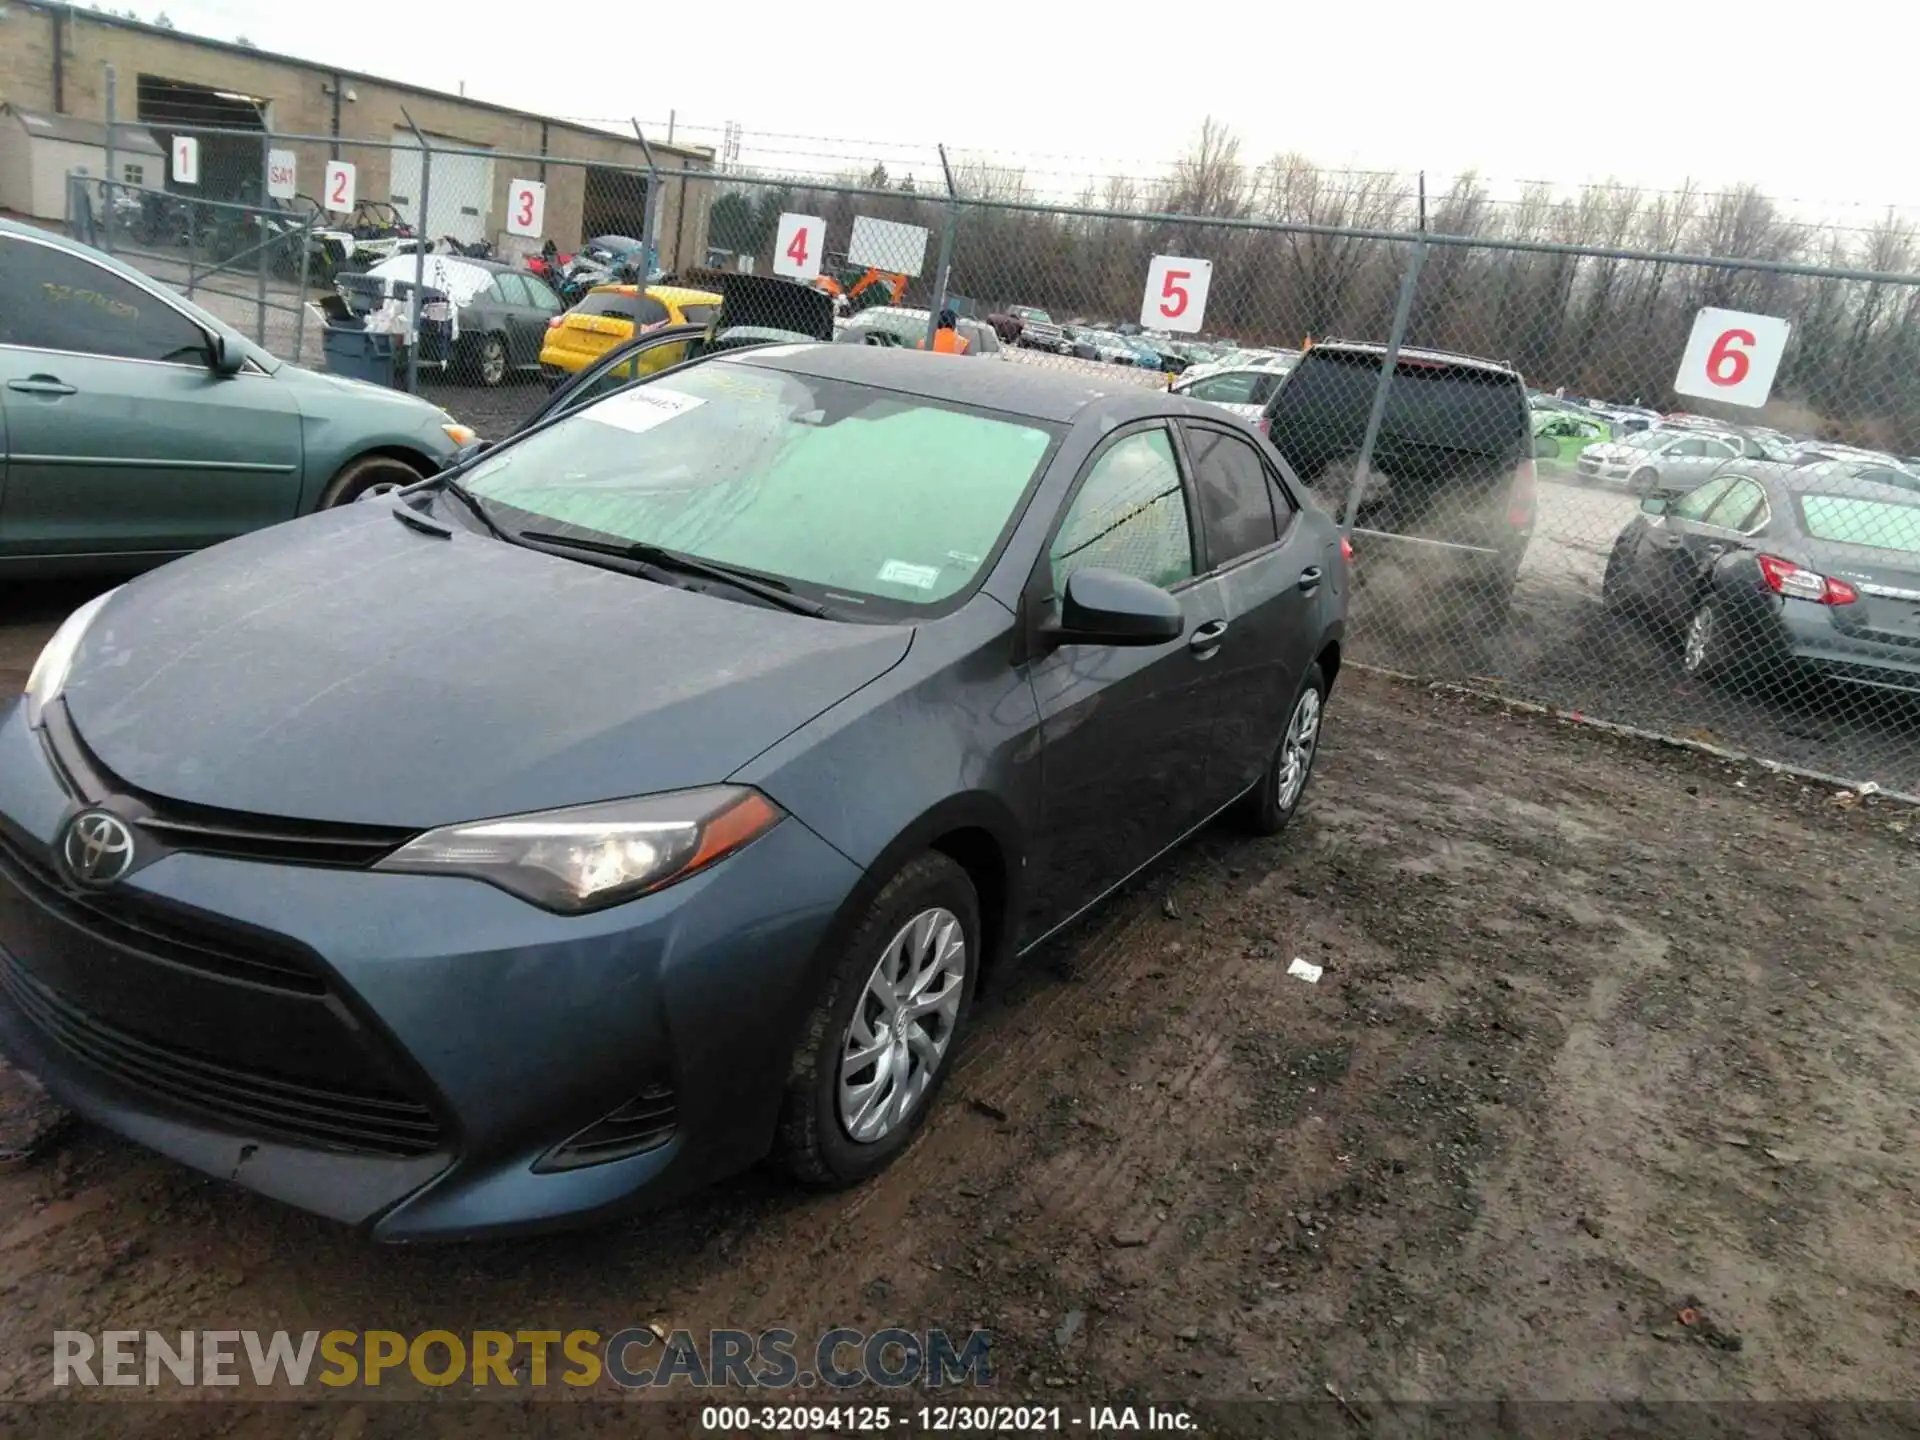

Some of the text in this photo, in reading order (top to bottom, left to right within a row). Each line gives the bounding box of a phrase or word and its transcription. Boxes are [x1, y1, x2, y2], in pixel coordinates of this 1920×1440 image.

[179, 144, 188, 175] 1
[271, 166, 294, 184] SA1
[332, 171, 346, 203] 2
[517, 191, 534, 226] 3
[787, 227, 809, 266] 4
[1158, 269, 1191, 318] 5
[1704, 328, 1756, 387] 6
